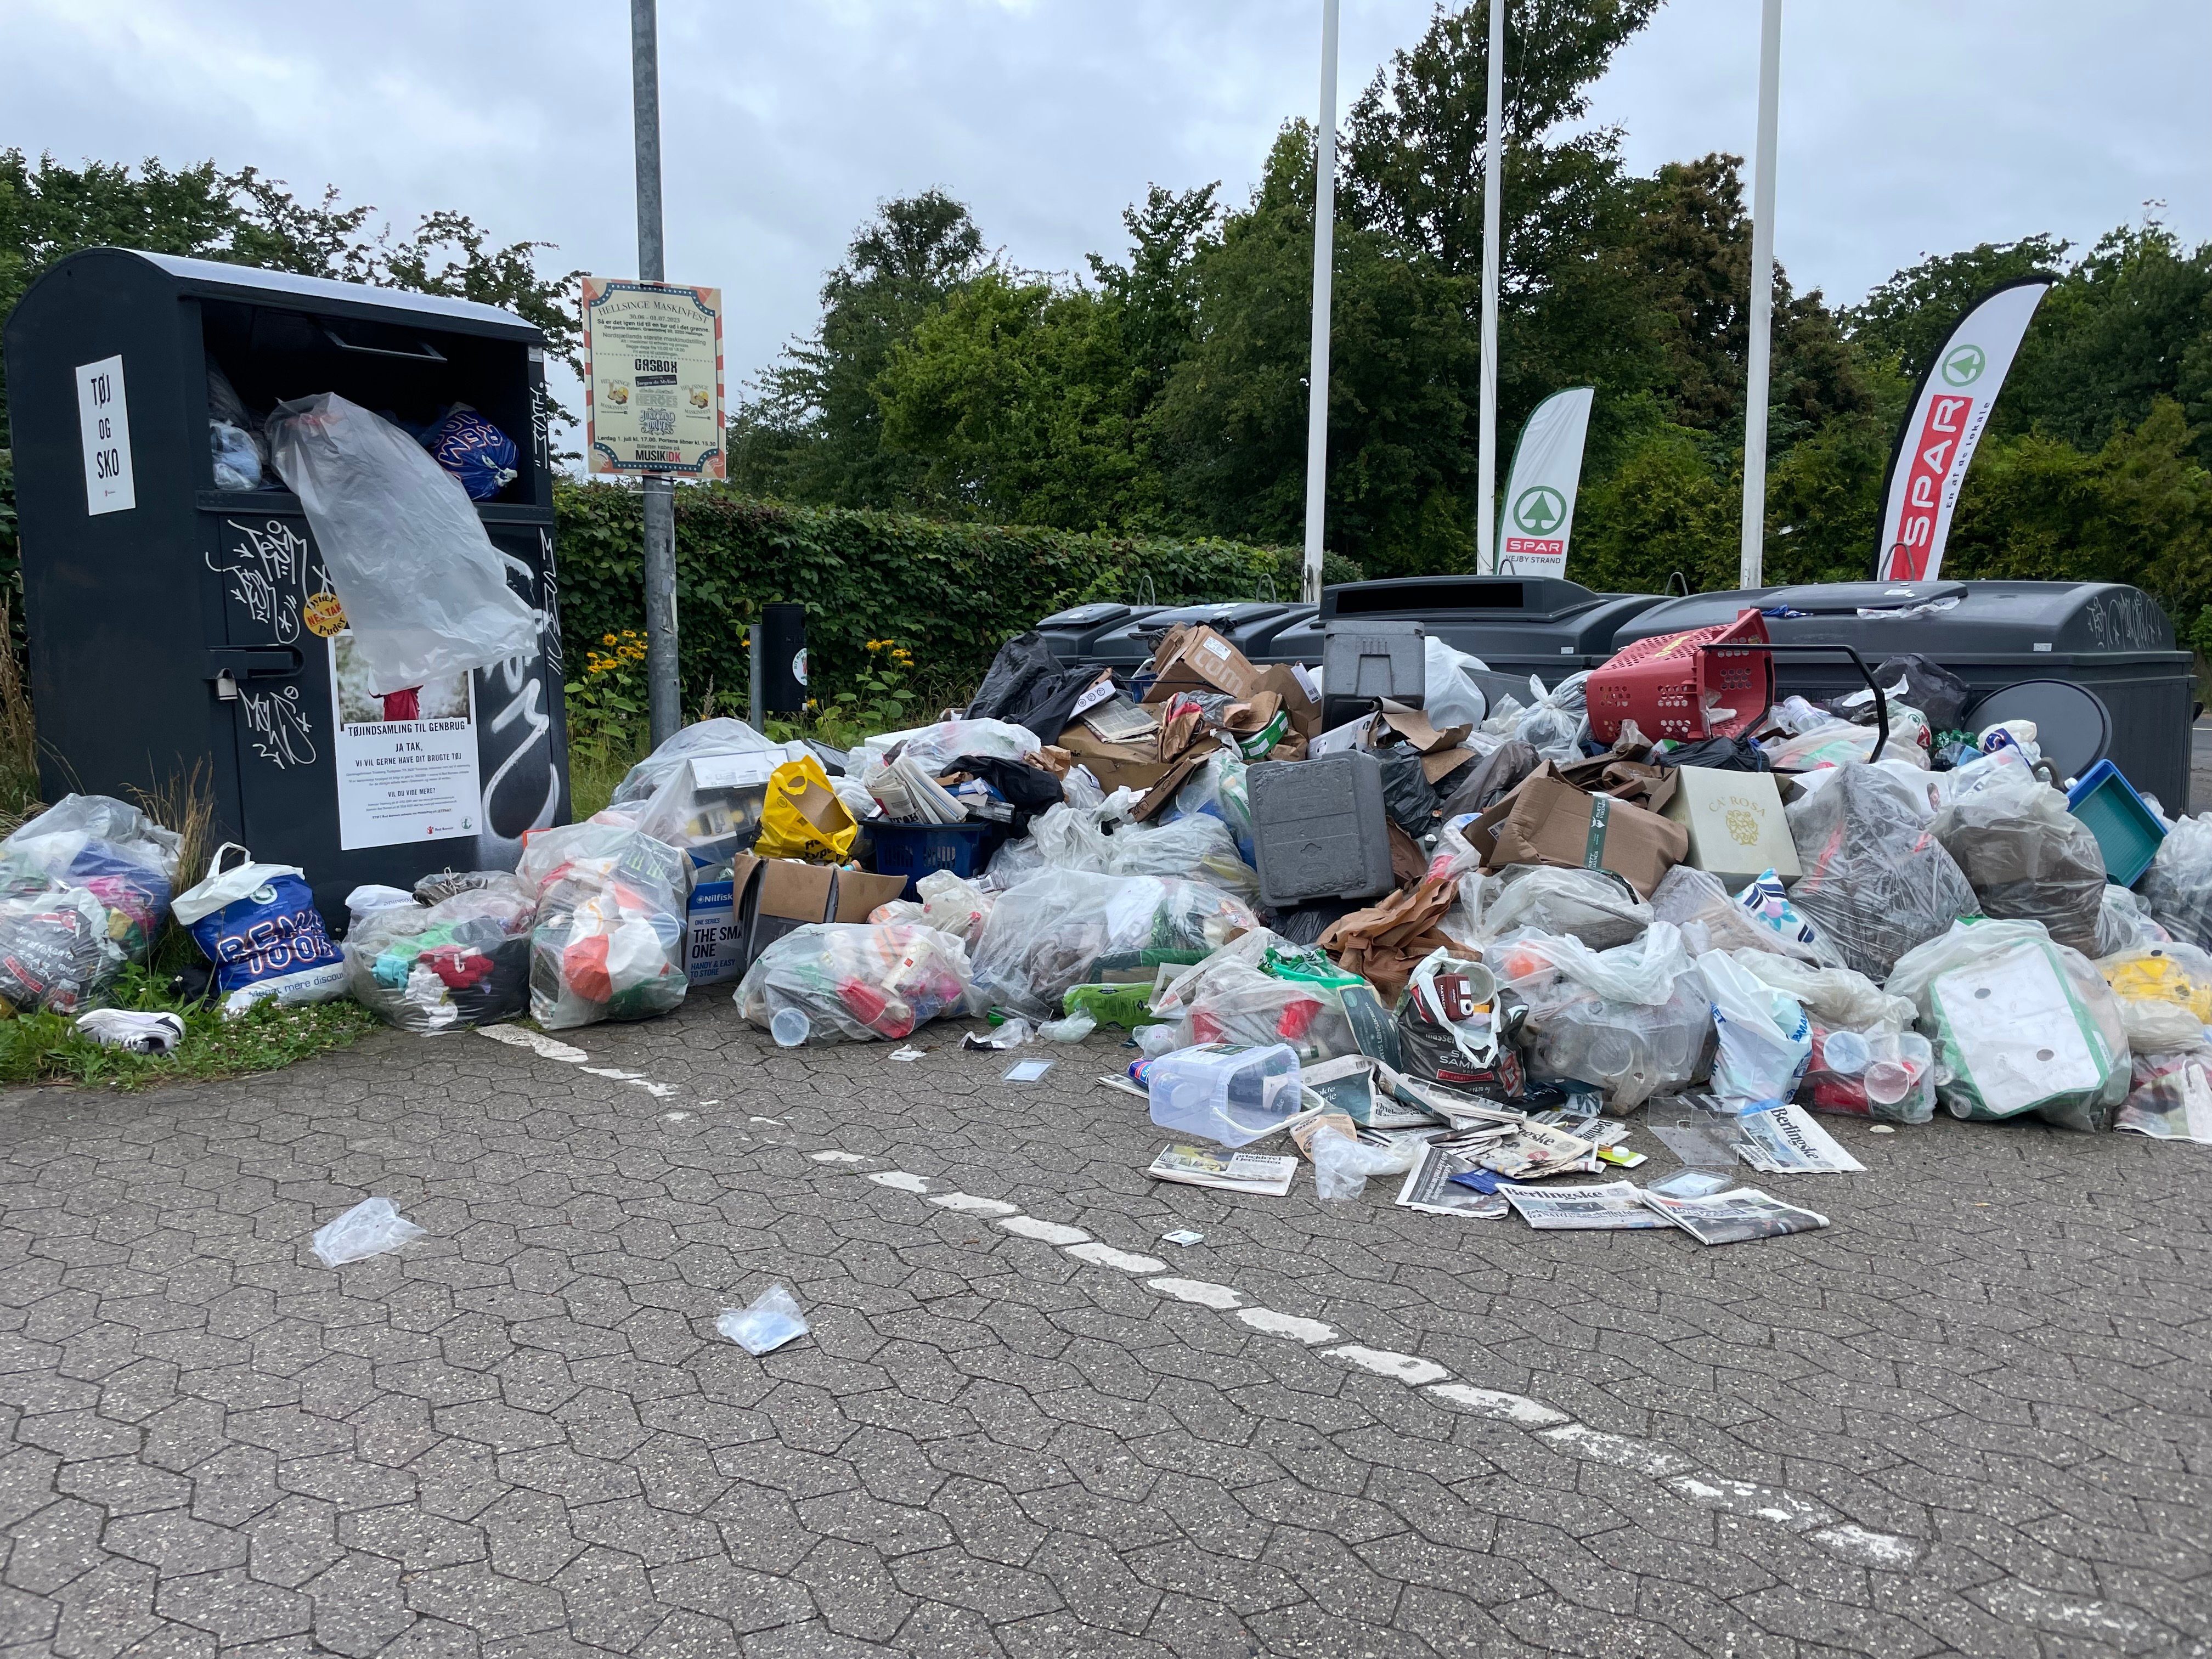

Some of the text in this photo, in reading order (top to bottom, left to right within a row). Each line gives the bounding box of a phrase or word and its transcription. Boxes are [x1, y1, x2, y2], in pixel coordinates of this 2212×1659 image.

[598, 301, 709, 324] HELLSINGE MASKINFEST
[664, 336, 706, 346] maskinudstilling
[635, 359, 678, 373] GASBOX
[91, 373, 111, 409] TØJ
[99, 417, 111, 439] OG
[97, 448, 120, 479] SKO
[636, 450, 681, 463] MUSIK DK
[1904, 399, 1965, 548] SPAR
[1510, 540, 1560, 552] SPAR
[307, 603, 342, 625] NEJ TAK
[318, 617, 345, 635] Puder
[348, 721, 465, 737] TØJINDSAMLING TIL GENBRUG
[396, 742, 423, 752] JA TAK,
[376, 757, 396, 765] GERNE
[398, 756, 414, 764] HAVE
[427, 753, 450, 762] BRUGTE
[1729, 796, 1765, 816] ROSA
[704, 893, 733, 902] Nilfisk
[694, 926, 743, 943] THE SMA
[692, 944, 716, 958] ONE
[691, 962, 712, 970] HANDY
[720, 958, 736, 967] EASY
[699, 968, 719, 977] STORE
[285, 980, 311, 992] mere
[1519, 1127, 1555, 1146] ngske
[1771, 1108, 1819, 1159] Berlingske
[1504, 1187, 1605, 1201] Berlingske
